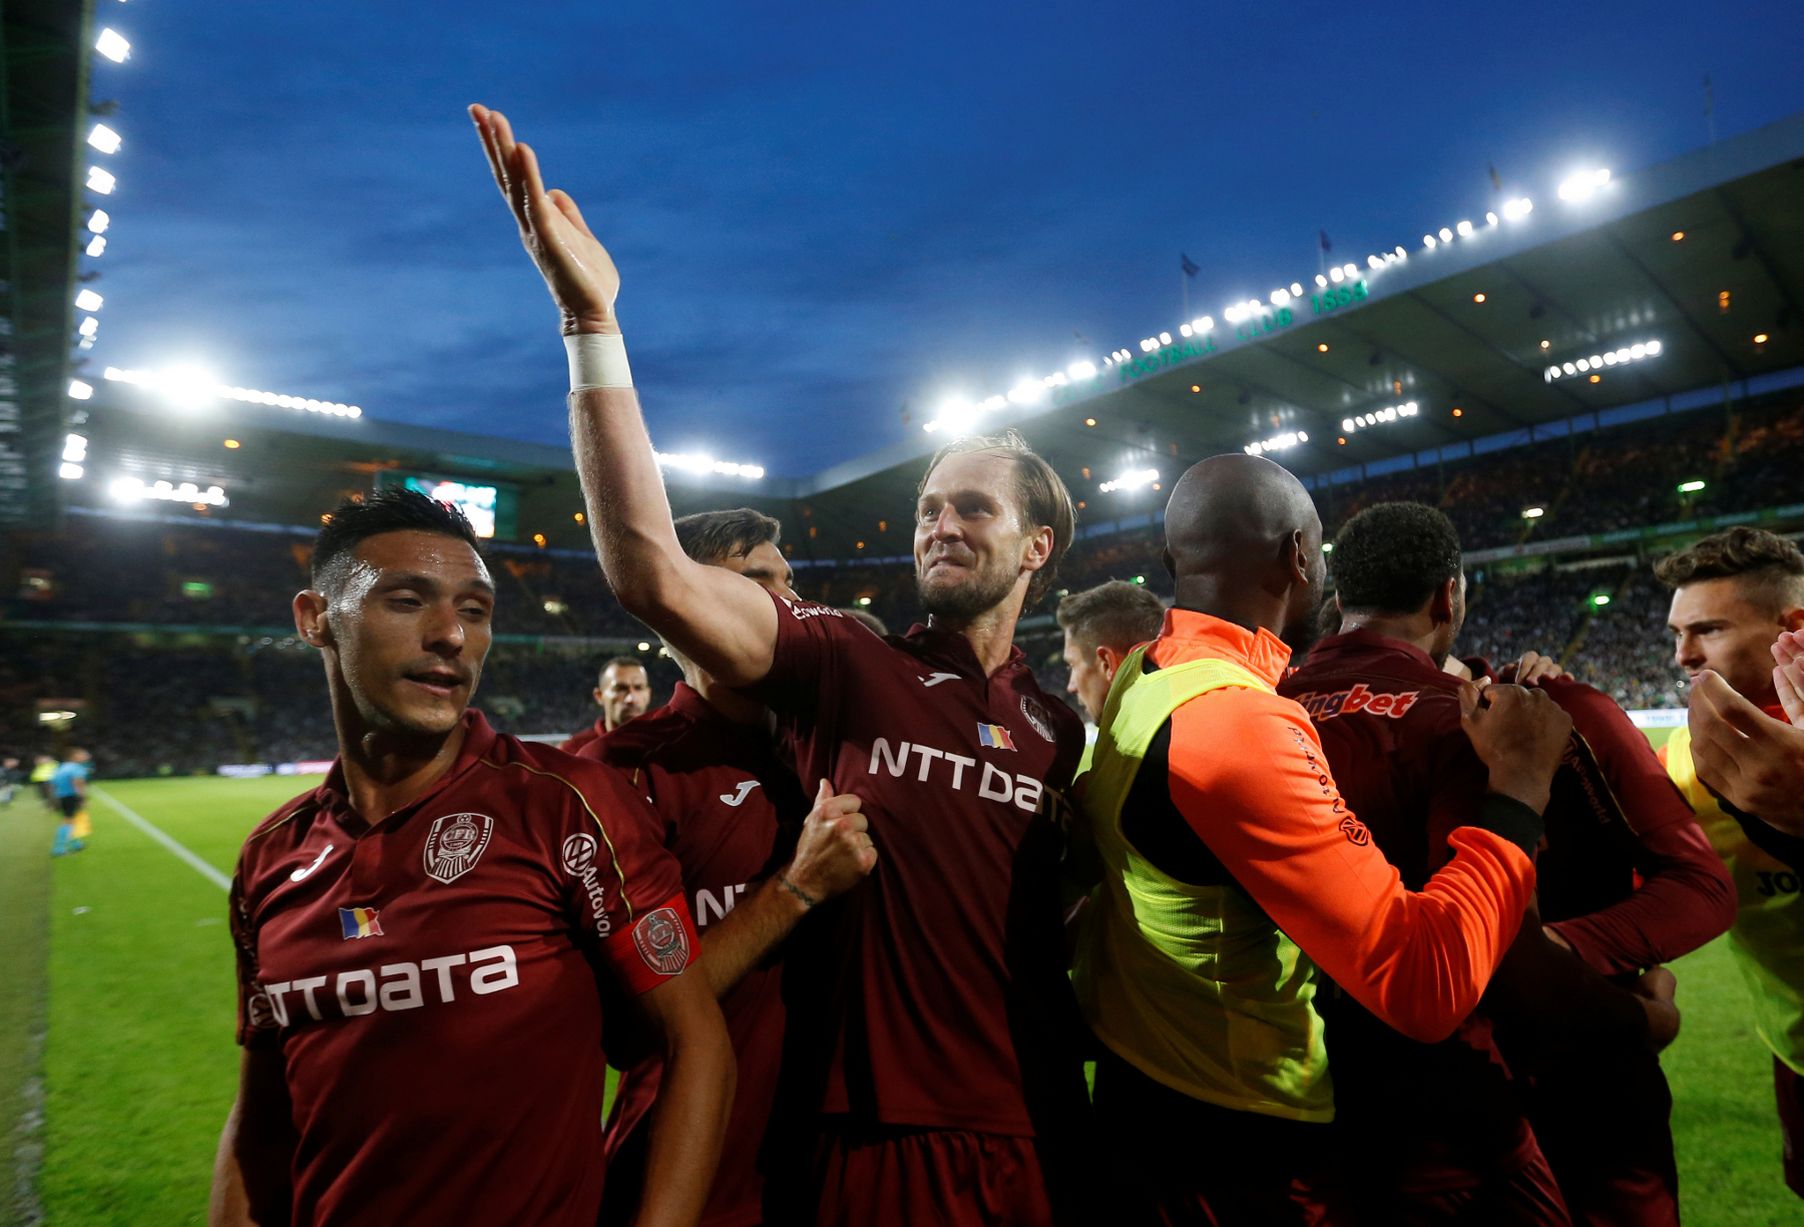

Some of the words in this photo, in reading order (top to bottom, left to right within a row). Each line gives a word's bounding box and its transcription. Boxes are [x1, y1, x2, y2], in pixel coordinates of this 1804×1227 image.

[1119, 337, 1217, 381] FOOTBALL
[1235, 308, 1293, 341] CLUB
[868, 737, 975, 789] NTT
